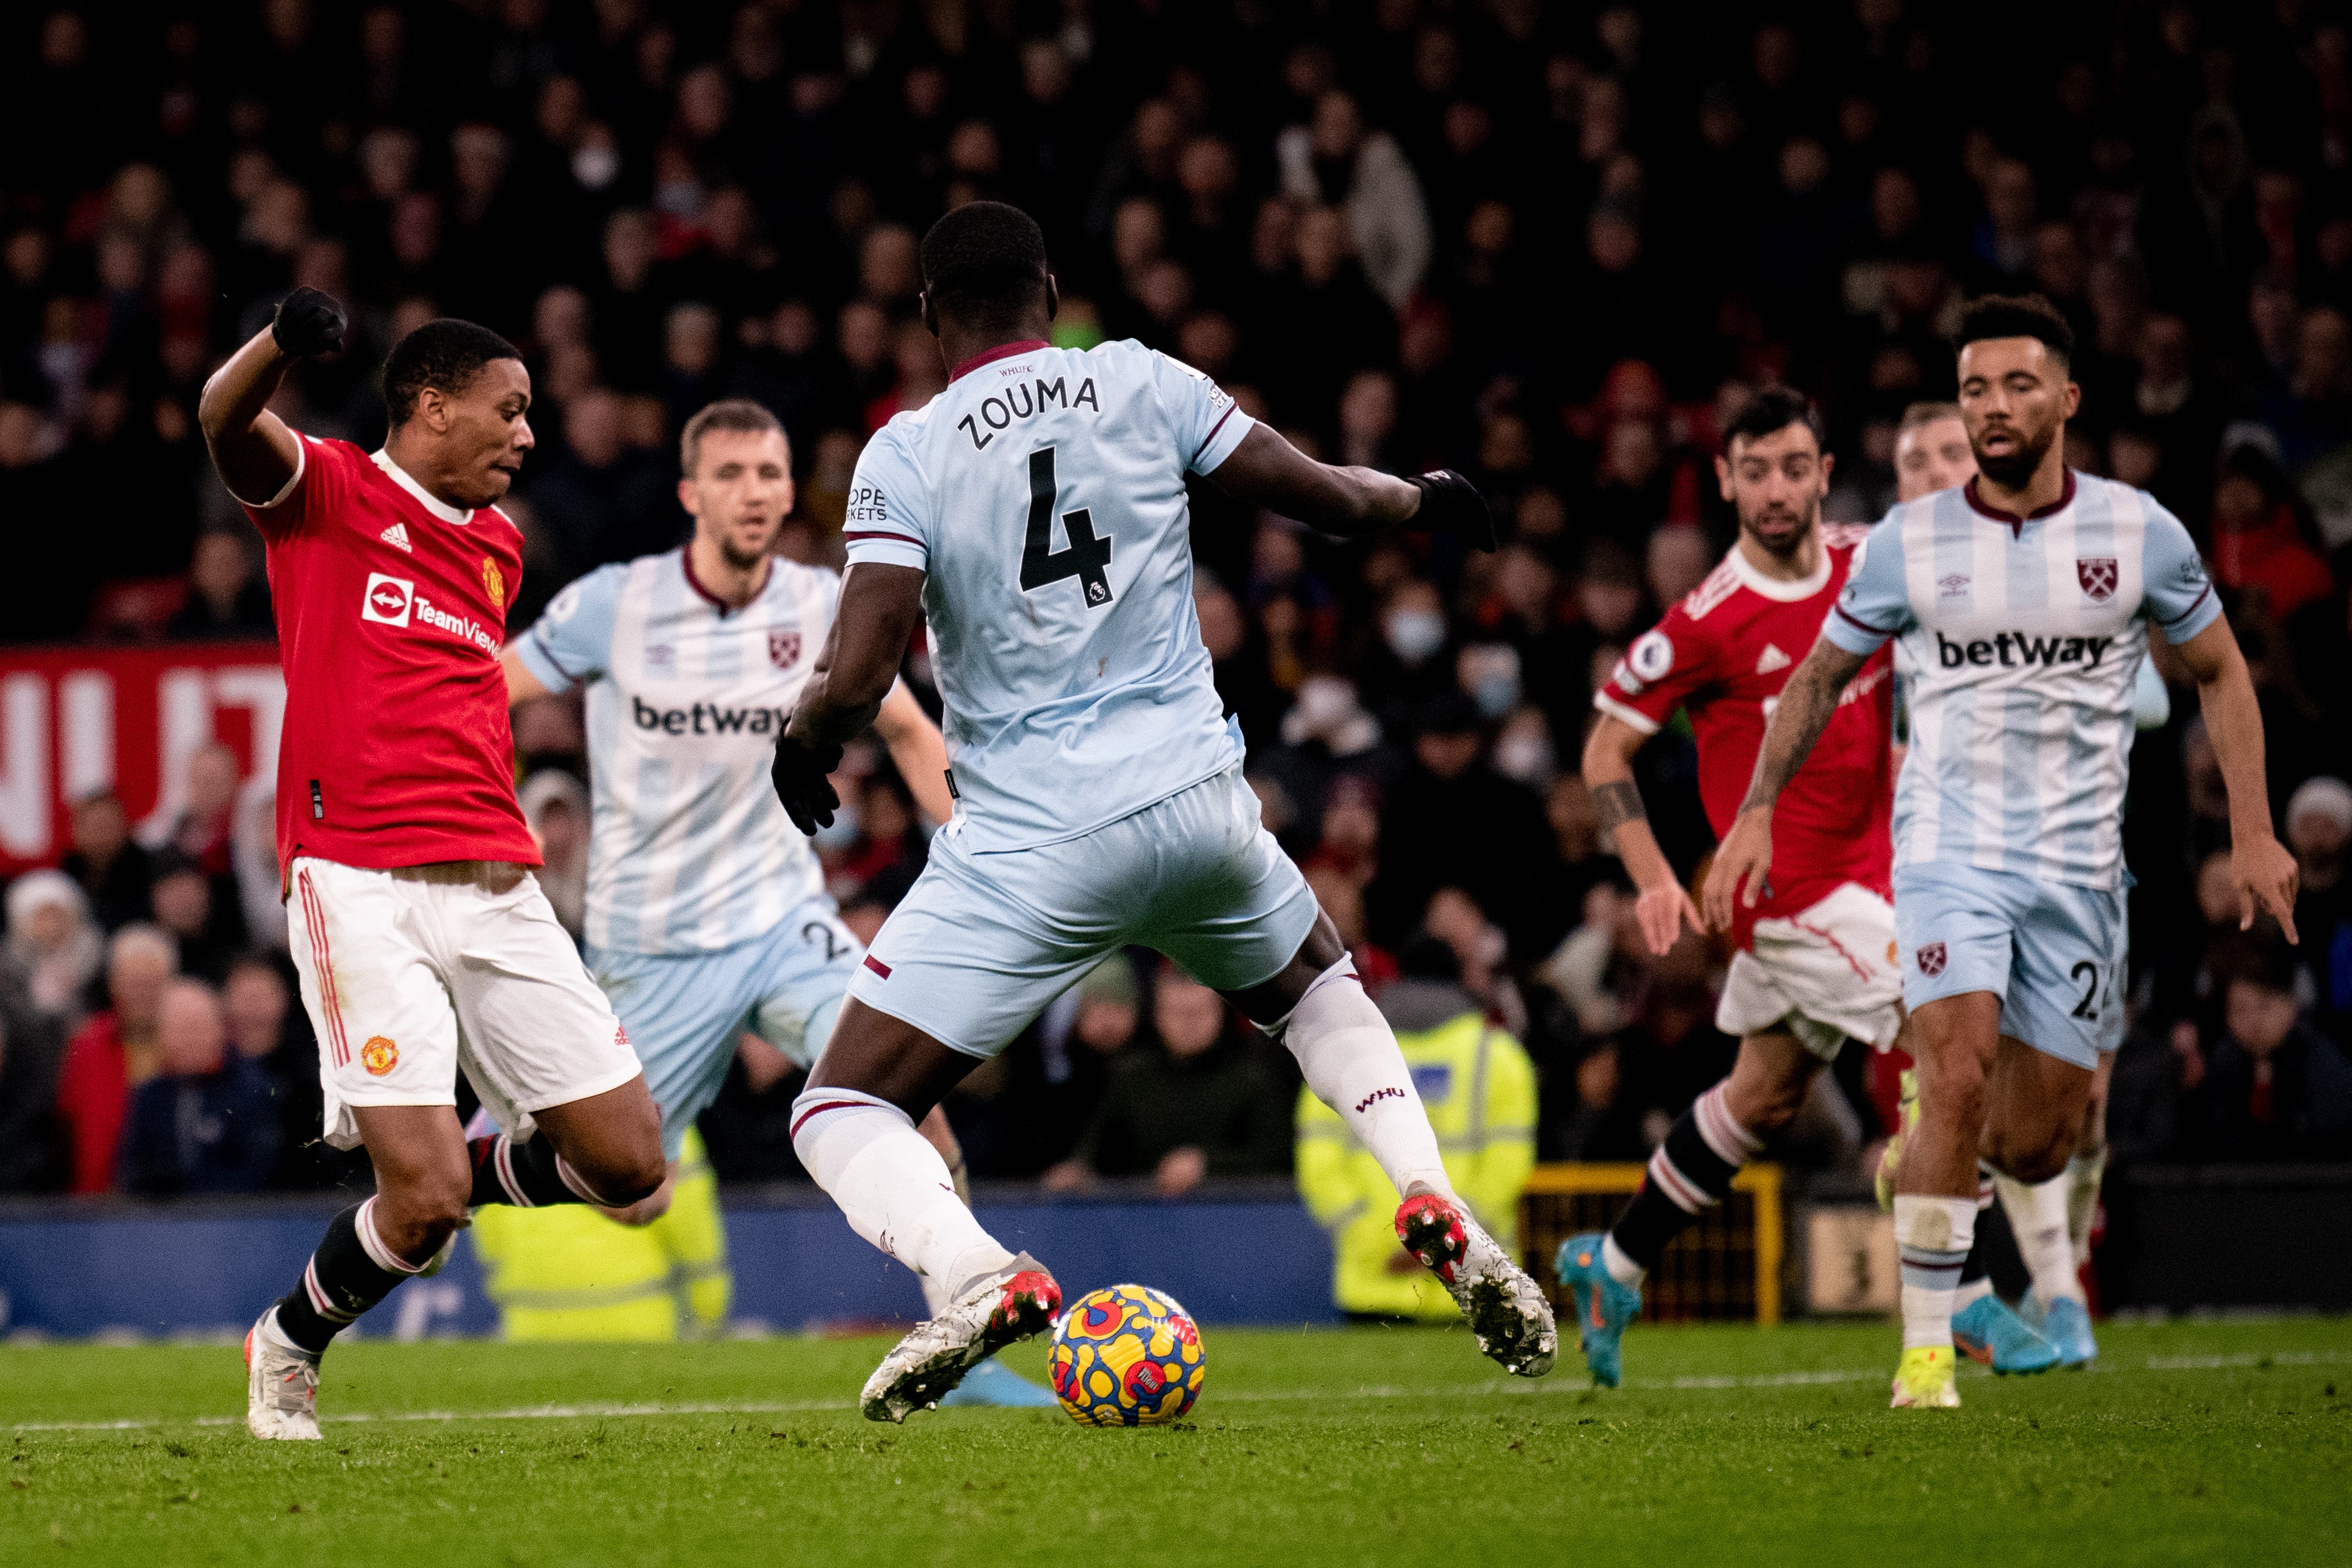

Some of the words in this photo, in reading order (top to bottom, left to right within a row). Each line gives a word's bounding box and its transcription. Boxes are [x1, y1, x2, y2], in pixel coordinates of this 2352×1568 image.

[999, 365, 1035, 377] WHUFC
[957, 376, 1099, 450] ZOUMA
[380, 532, 413, 553] adidas
[1019, 447, 1113, 609] 4
[1936, 630, 2113, 672] betway
[1355, 1088, 1405, 1113] WHU
